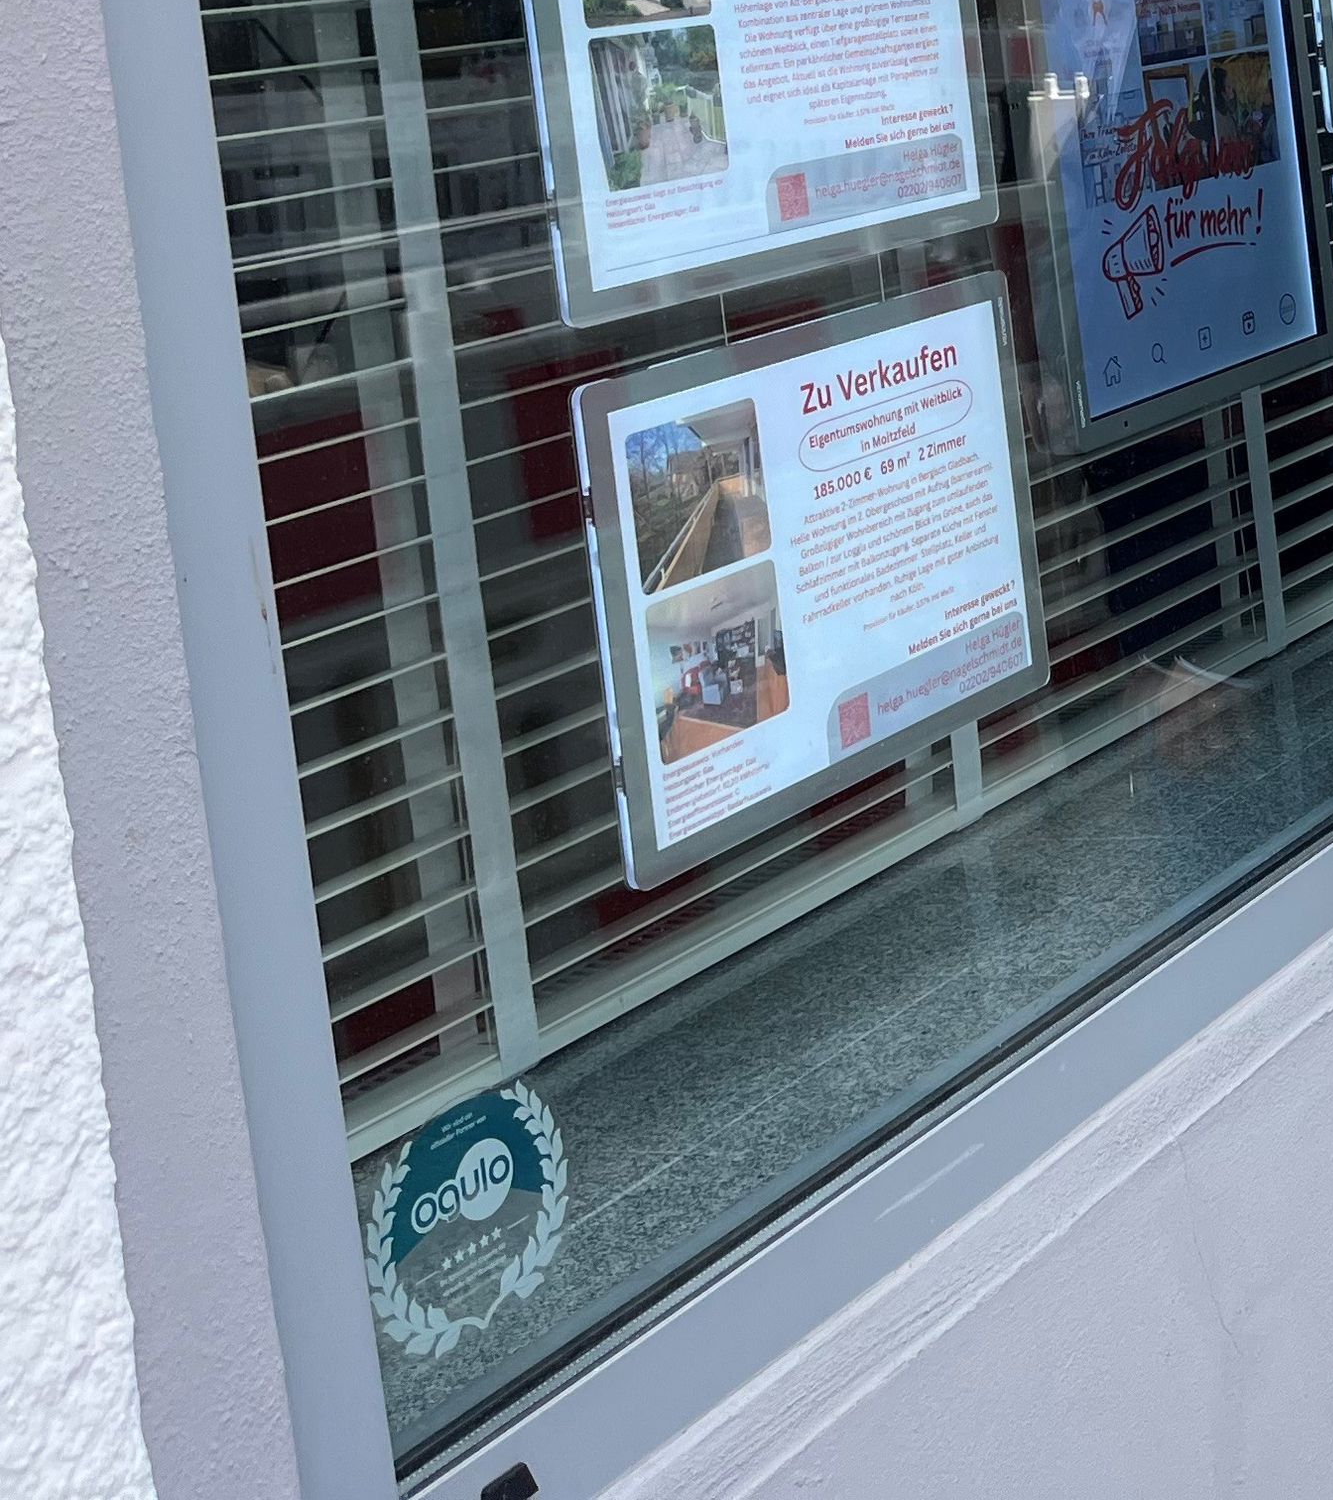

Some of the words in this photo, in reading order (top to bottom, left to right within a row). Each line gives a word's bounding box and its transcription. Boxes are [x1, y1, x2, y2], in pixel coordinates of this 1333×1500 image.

[844, 135, 875, 150] Melden
[875, 133, 889, 144] Sie
[889, 128, 906, 142] sich
[906, 126, 929, 141] gerne
[929, 123, 942, 134] bei
[942, 120, 956, 132] uns
[880, 111, 918, 127] Interesse
[918, 104, 949, 122] geweckt
[1164, 197, 1197, 249] für
[1200, 194, 1252, 238] mehr
[799, 381, 833, 416] Zu
[836, 343, 959, 402] Verkaufen
[808, 408, 904, 450] Eigentumswohnung
[903, 401, 920, 416] mit
[920, 386, 964, 410] Weitblick
[860, 438, 871, 453] in
[872, 421, 917, 449] Moitzfeld
[813, 470, 862, 501] 185.000
[863, 466, 873, 481] €
[880, 459, 895, 476] 69
[918, 447, 926, 462] 2
[926, 433, 968, 459] Zimmer
[943, 598, 980, 621] Interesse
[980, 581, 1011, 607] geweckt
[907, 634, 939, 656] Melden
[939, 627, 952, 641] Sie
[952, 619, 969, 635] sich
[991, 605, 1004, 617] bei
[1004, 597, 1018, 609] uns
[964, 634, 991, 654] Helga
